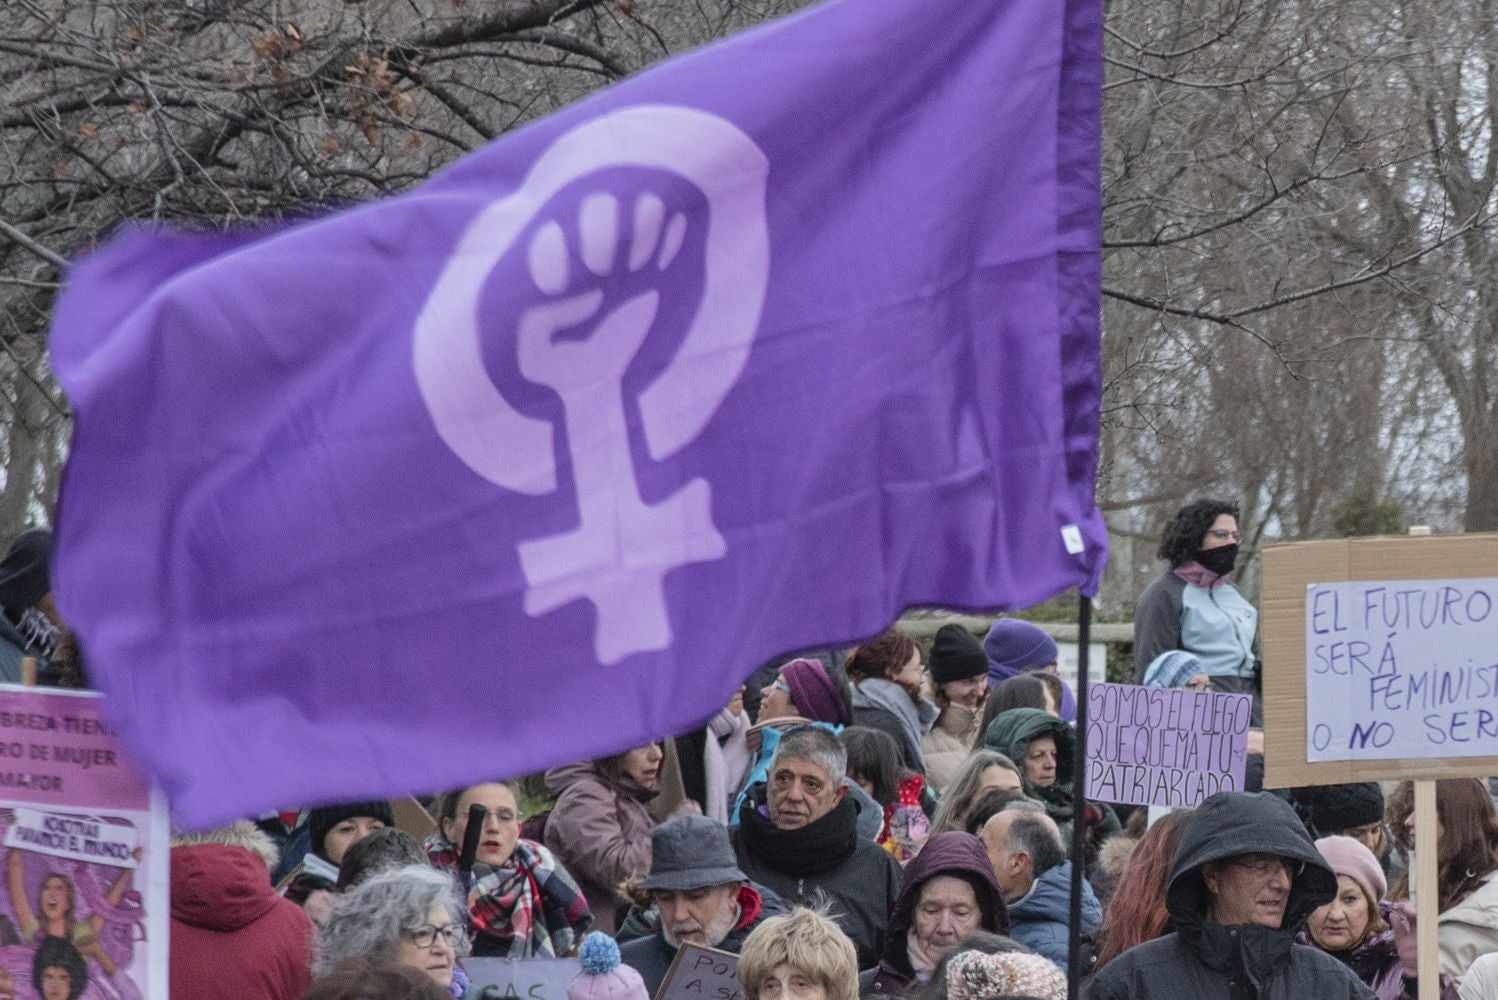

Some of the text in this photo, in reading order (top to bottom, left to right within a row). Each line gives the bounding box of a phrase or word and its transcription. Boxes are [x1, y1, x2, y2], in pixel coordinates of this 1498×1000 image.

[1313, 586, 1492, 634] EL FUTURO
[1313, 631, 1397, 675] SERÁ
[64, 716, 118, 736] TIEN
[1089, 684, 1250, 735] SOMOS EL FUEGO
[1086, 722, 1233, 773] QUE QUEMA TU
[1312, 723, 1332, 751] O
[1349, 721, 1394, 749] NO
[29, 744, 48, 760] DE
[53, 746, 117, 769] MUJER
[686, 979, 702, 992] A
